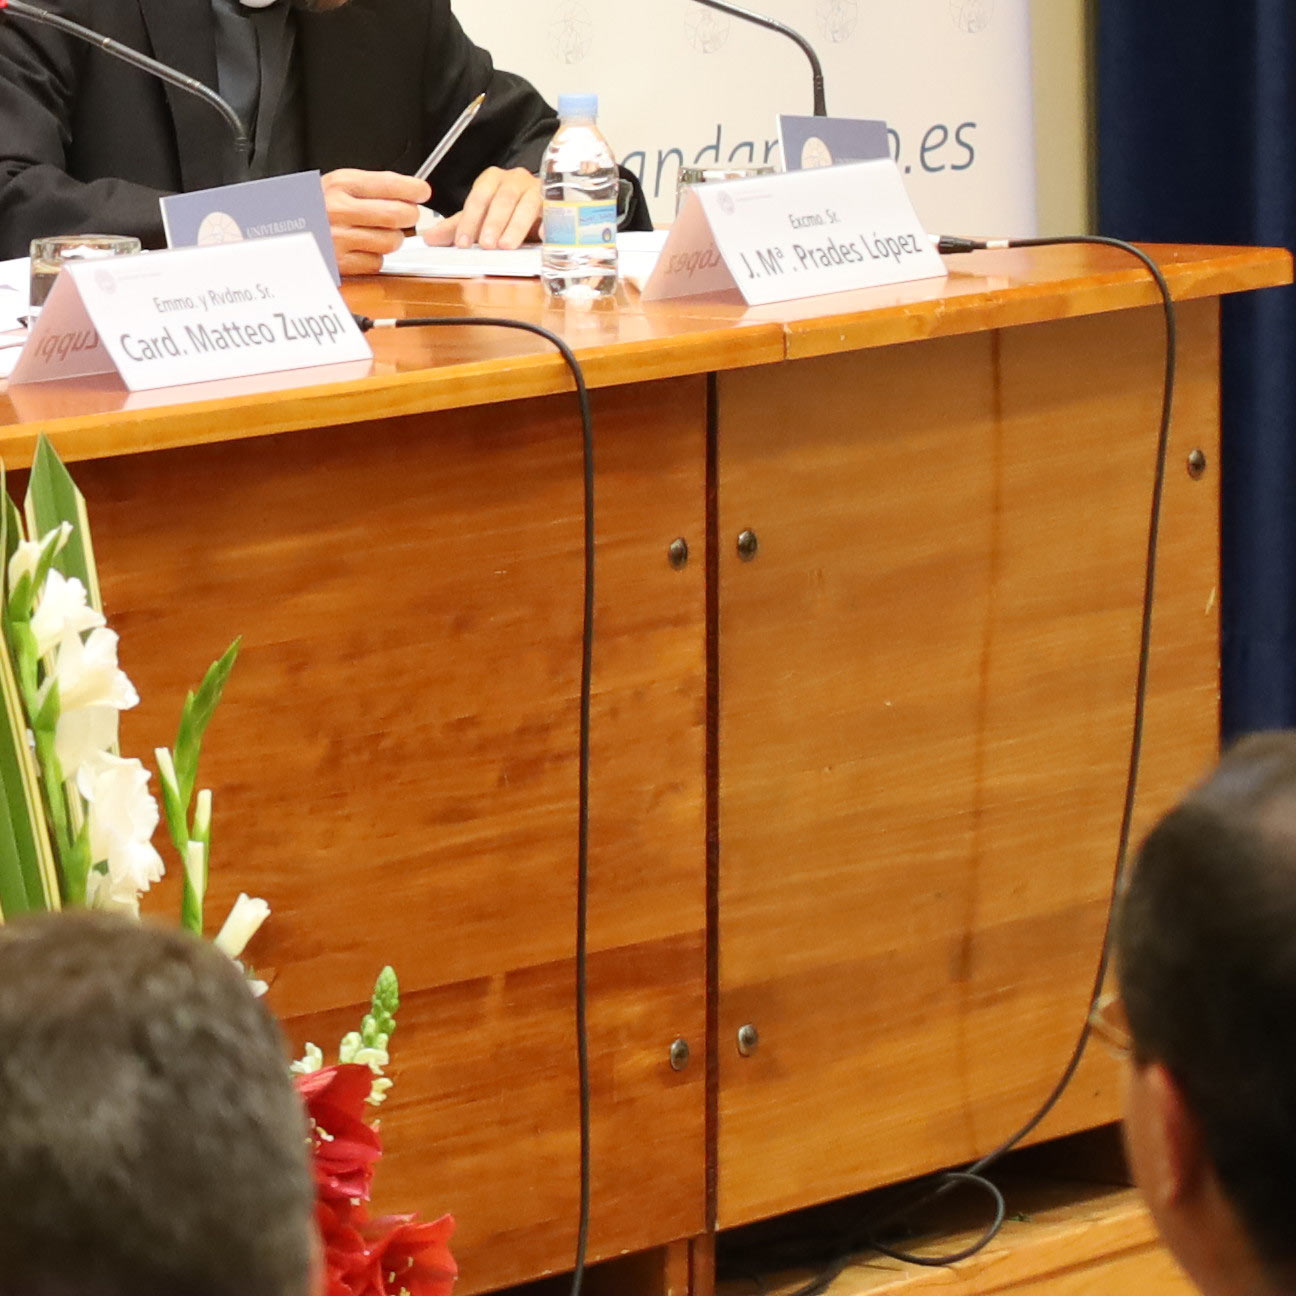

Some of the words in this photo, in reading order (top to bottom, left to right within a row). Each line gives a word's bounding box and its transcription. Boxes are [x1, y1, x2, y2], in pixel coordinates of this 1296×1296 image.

[793, 237, 863, 270] Prades
[860, 231, 922, 265] López
[154, 294, 199, 313] Emmo.
[199, 297, 209, 312] y
[210, 287, 256, 308] Rvdmo.
[256, 283, 275, 301] Sr.
[120, 328, 188, 363] Card.
[191, 320, 275, 355] Matteo
[274, 306, 346, 345] Zuppi
